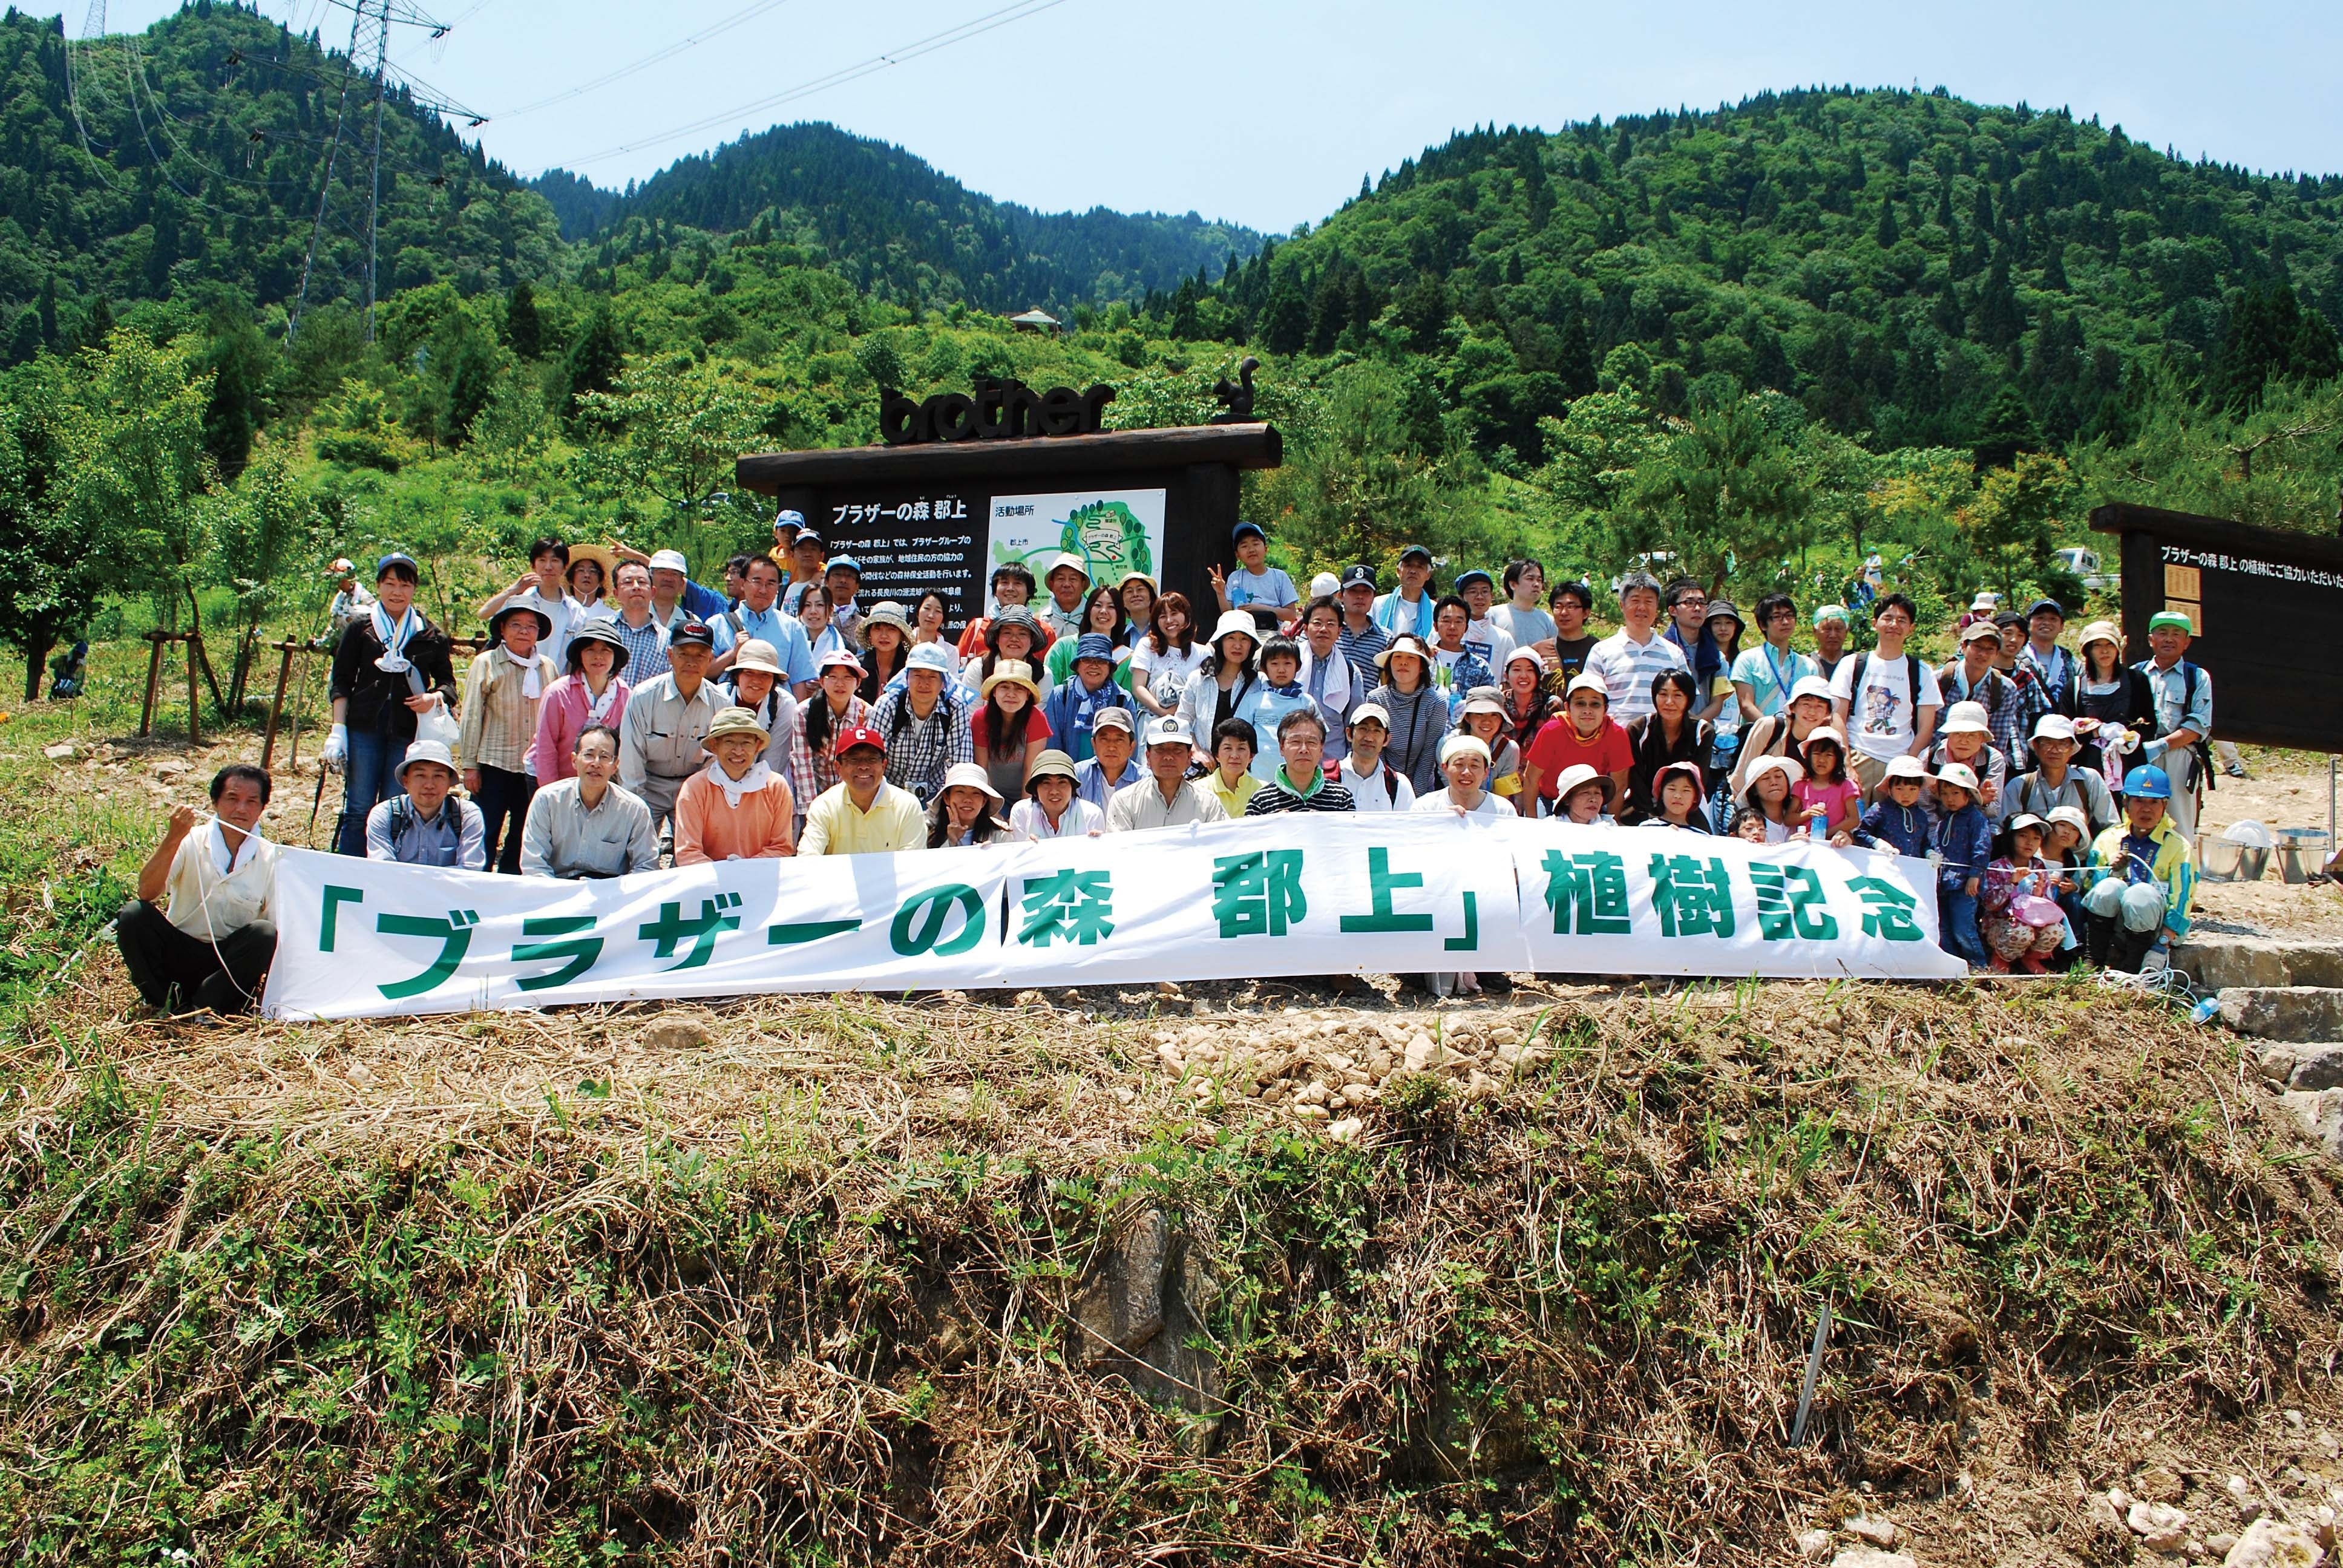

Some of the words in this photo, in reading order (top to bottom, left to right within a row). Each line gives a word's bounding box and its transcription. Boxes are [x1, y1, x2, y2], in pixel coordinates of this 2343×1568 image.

[880, 377, 1115, 443] brother
[833, 501, 929, 524] ブラザーの森
[934, 499, 967, 520] 郡上
[995, 505, 1034, 517] 活動場所
[855, 728, 867, 740] C
[320, 868, 1115, 1000] 「ブラザーの森
